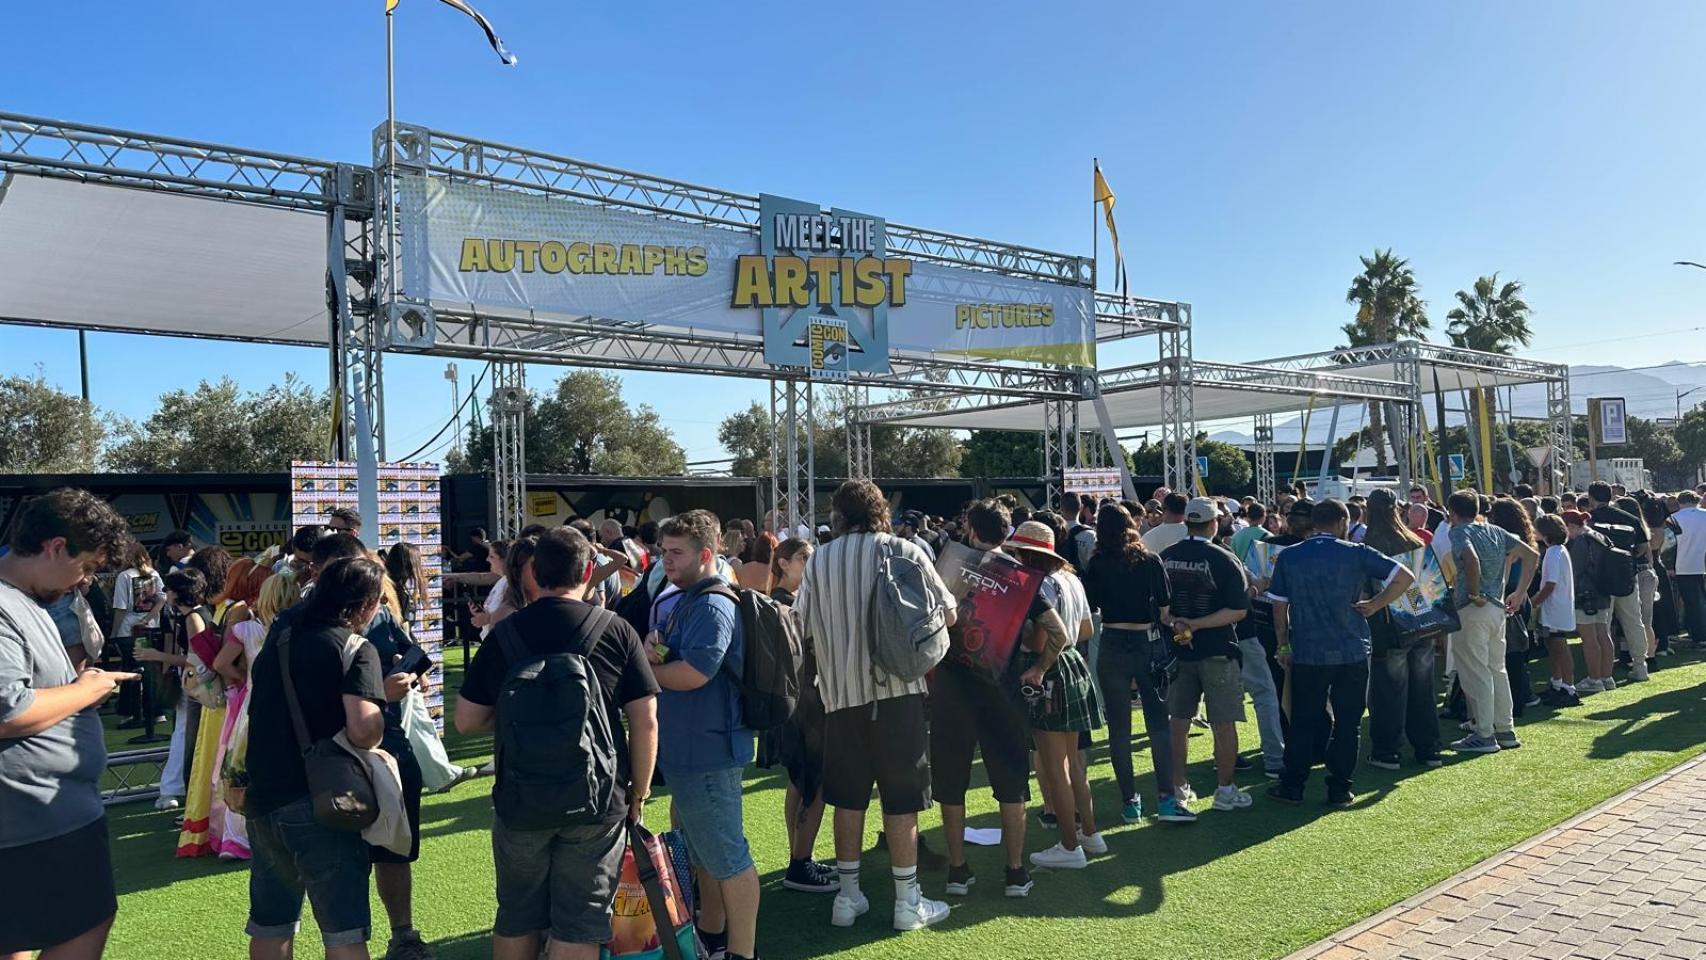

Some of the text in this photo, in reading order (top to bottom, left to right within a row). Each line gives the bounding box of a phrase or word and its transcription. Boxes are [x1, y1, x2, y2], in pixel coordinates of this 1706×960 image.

[775, 213, 877, 253] MEET THE
[458, 237, 709, 277] AUTOGRAPHS
[730, 255, 913, 309] ARTIST
[955, 303, 1055, 329] PICTURES
[811, 325, 824, 369] COMIC
[823, 326, 845, 342] CON
[1605, 403, 1617, 426] P
[243, 531, 286, 552] CON
[960, 566, 1009, 594] TRON
